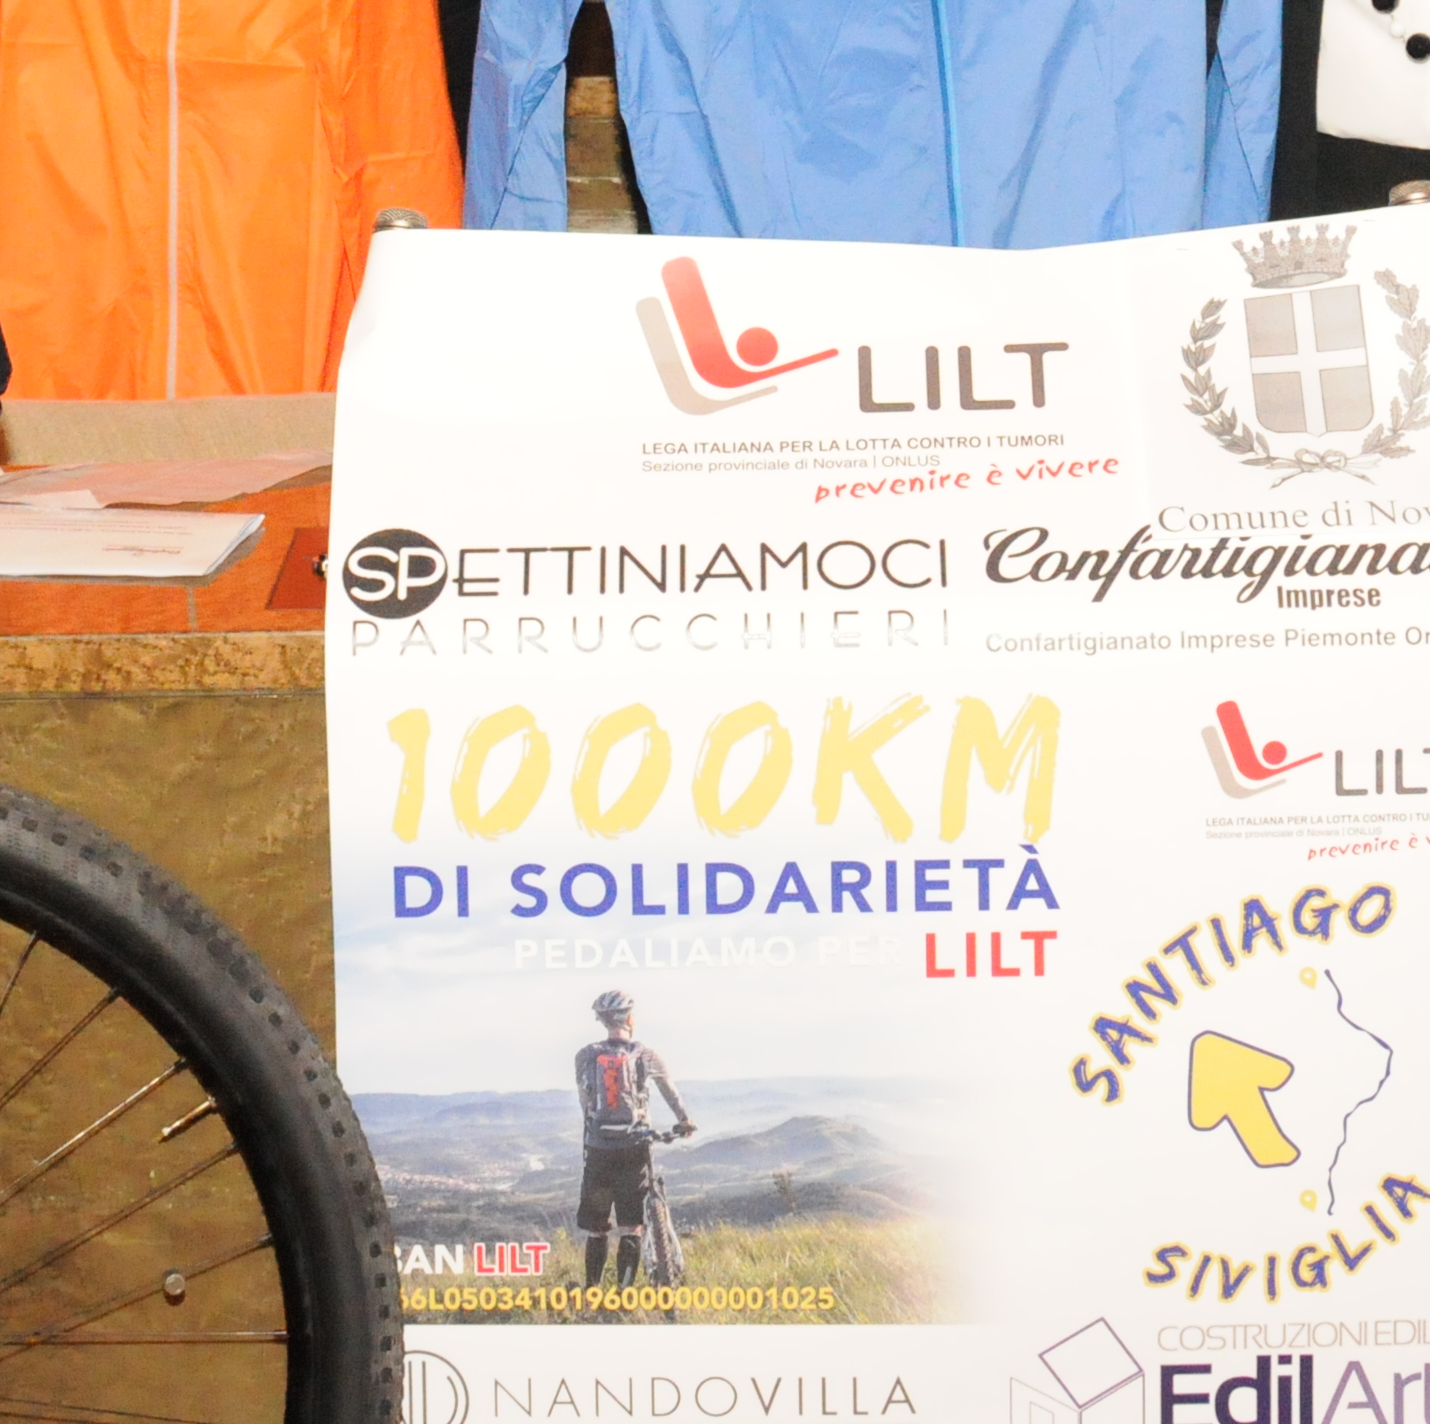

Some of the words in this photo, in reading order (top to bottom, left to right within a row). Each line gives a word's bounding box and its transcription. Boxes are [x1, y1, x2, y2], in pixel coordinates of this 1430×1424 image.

[857, 341, 1070, 414] LILT
[642, 442, 689, 455] LEGA
[694, 441, 774, 454] ITALIANA
[779, 440, 813, 453] PER
[818, 439, 841, 452] LA
[846, 437, 902, 451] LOTTA
[906, 436, 982, 450] CONTRO
[986, 436, 991, 448] I
[997, 434, 1064, 448] TUMORI
[641, 460, 704, 473] Sezione
[708, 459, 790, 475] provinciale
[794, 458, 809, 471] di
[813, 457, 868, 470] Novara
[881, 454, 941, 468] ONLUS
[814, 470, 971, 504] prevenire
[986, 463, 1003, 485] è
[1015, 457, 1120, 481] vivere
[1158, 506, 1310, 533] Comune
[1321, 500, 1353, 528] di
[345, 538, 948, 606] SPETTINIAMOCI
[1276, 585, 1382, 611] Imprese
[351, 609, 949, 656] PARRUCCHIERI
[984, 632, 1173, 657] Confartigianato
[1180, 629, 1276, 654] Imprese
[1284, 628, 1397, 649] Piemonte
[386, 692, 1062, 844] 1000KM
[1205, 817, 1233, 827] LEGA
[1236, 816, 1284, 826] ITALIANA
[1287, 816, 1308, 825] PER
[1310, 815, 1324, 825] LA
[1326, 814, 1360, 824] LOTTA
[1362, 813, 1407, 823] CONTRO
[1307, 837, 1400, 861] prevenire
[1408, 832, 1419, 849] è
[393, 865, 470, 918] DI
[509, 844, 1061, 919] SOLIDARIETÀ
[514, 936, 796, 970] PEDALIAMO
[817, 935, 903, 967] PER
[925, 930, 1058, 979] LILT
[1071, 883, 1396, 1104] SANTIAGO
[474, 1242, 551, 1277] LILT
[1157, 1320, 1368, 1352] COSTRUZIONI
[494, 1376, 917, 1418] NANDOVILLA
